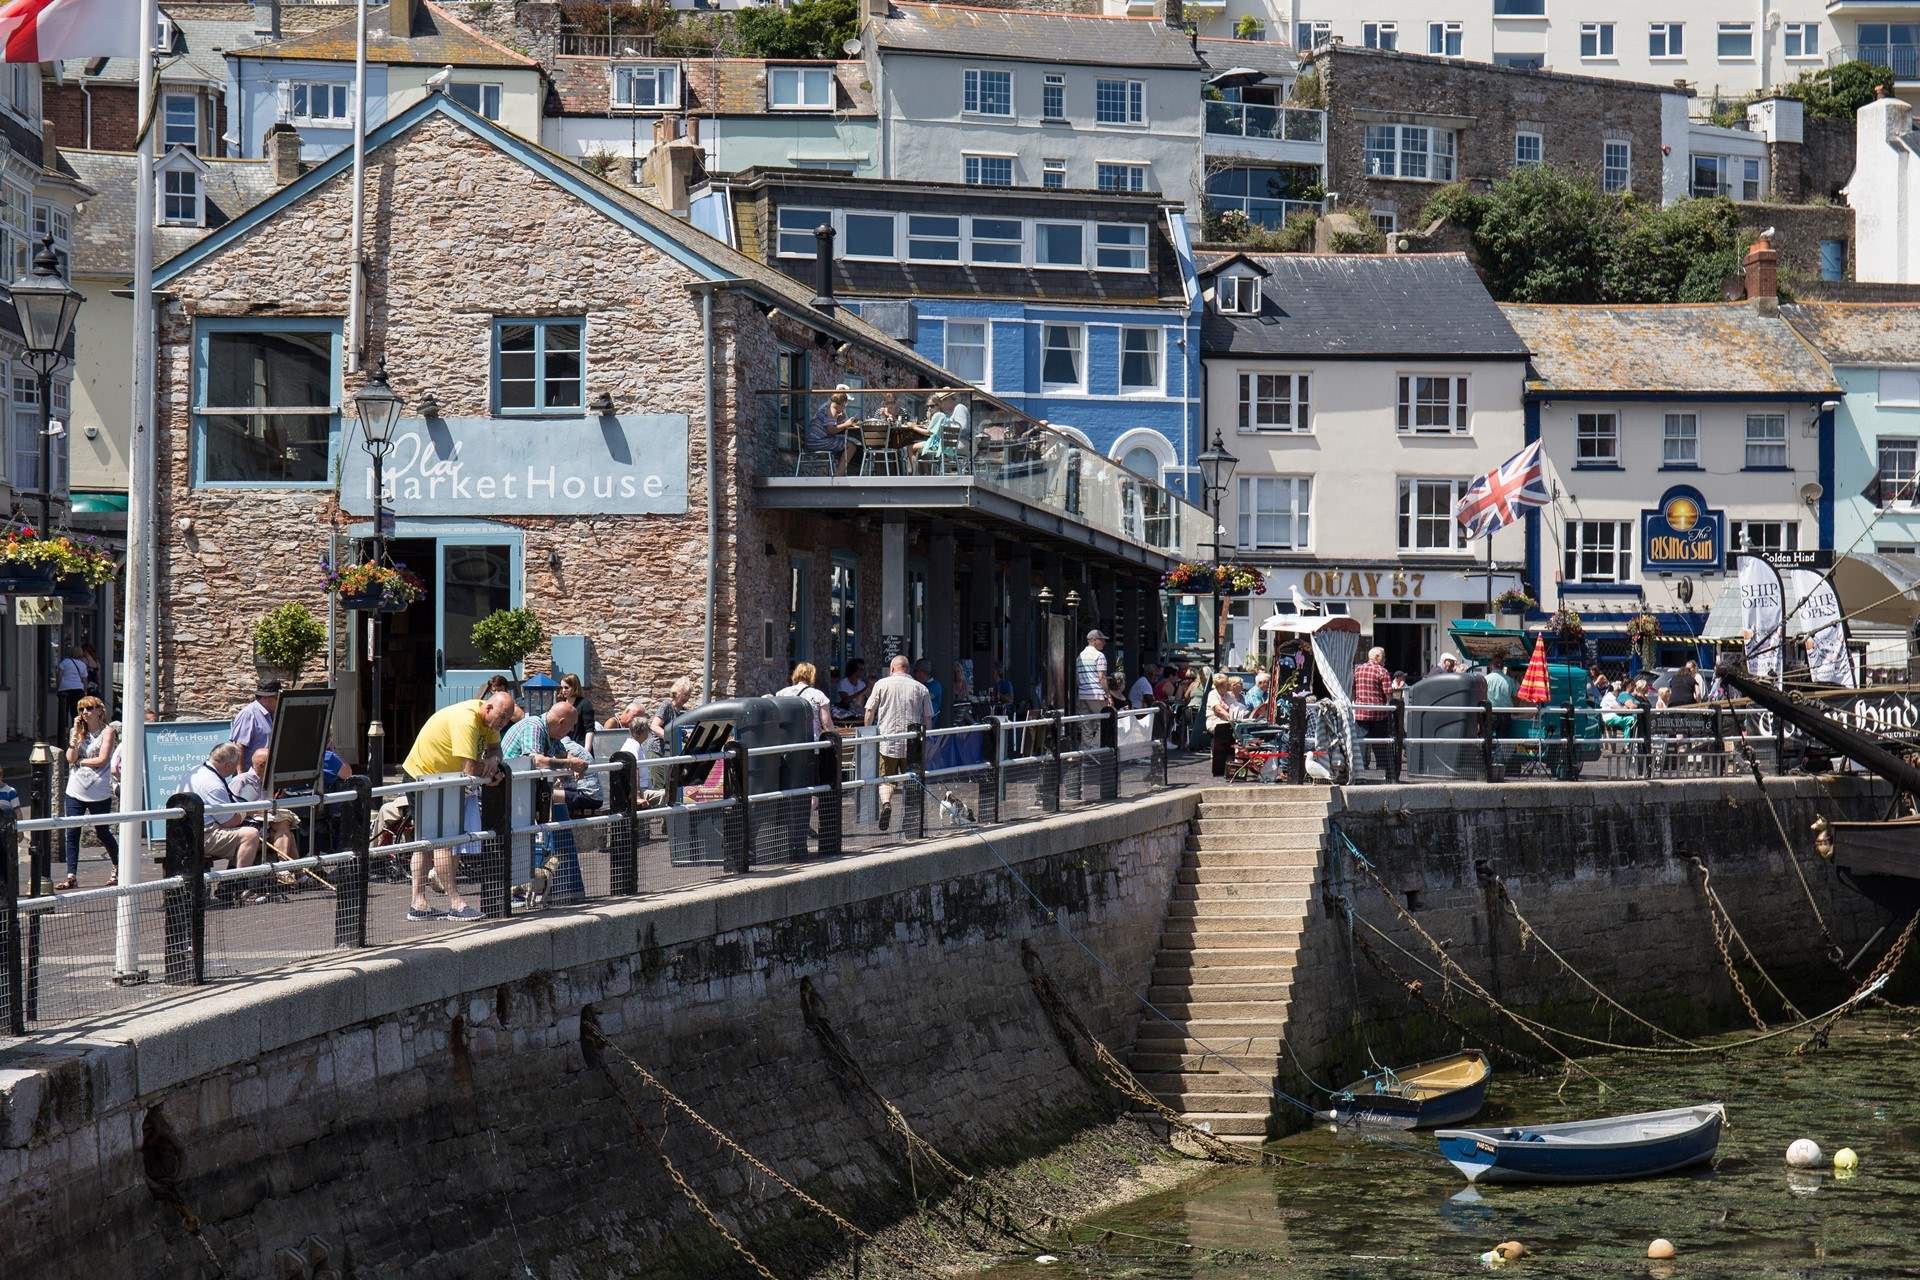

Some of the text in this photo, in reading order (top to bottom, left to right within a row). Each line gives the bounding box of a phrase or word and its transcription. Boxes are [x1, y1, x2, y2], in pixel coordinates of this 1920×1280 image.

[366, 465, 664, 499] Market House
[1687, 526, 1712, 541] The
[1761, 552, 1816, 563] Golden Hind
[1303, 571, 1426, 597] QUAY 57
[1741, 583, 1778, 598] SHIP
[1742, 596, 1779, 609] OPEN
[1800, 592, 1835, 609] HIP
[190, 733, 219, 741] House
[152, 754, 185, 762] Freshly
